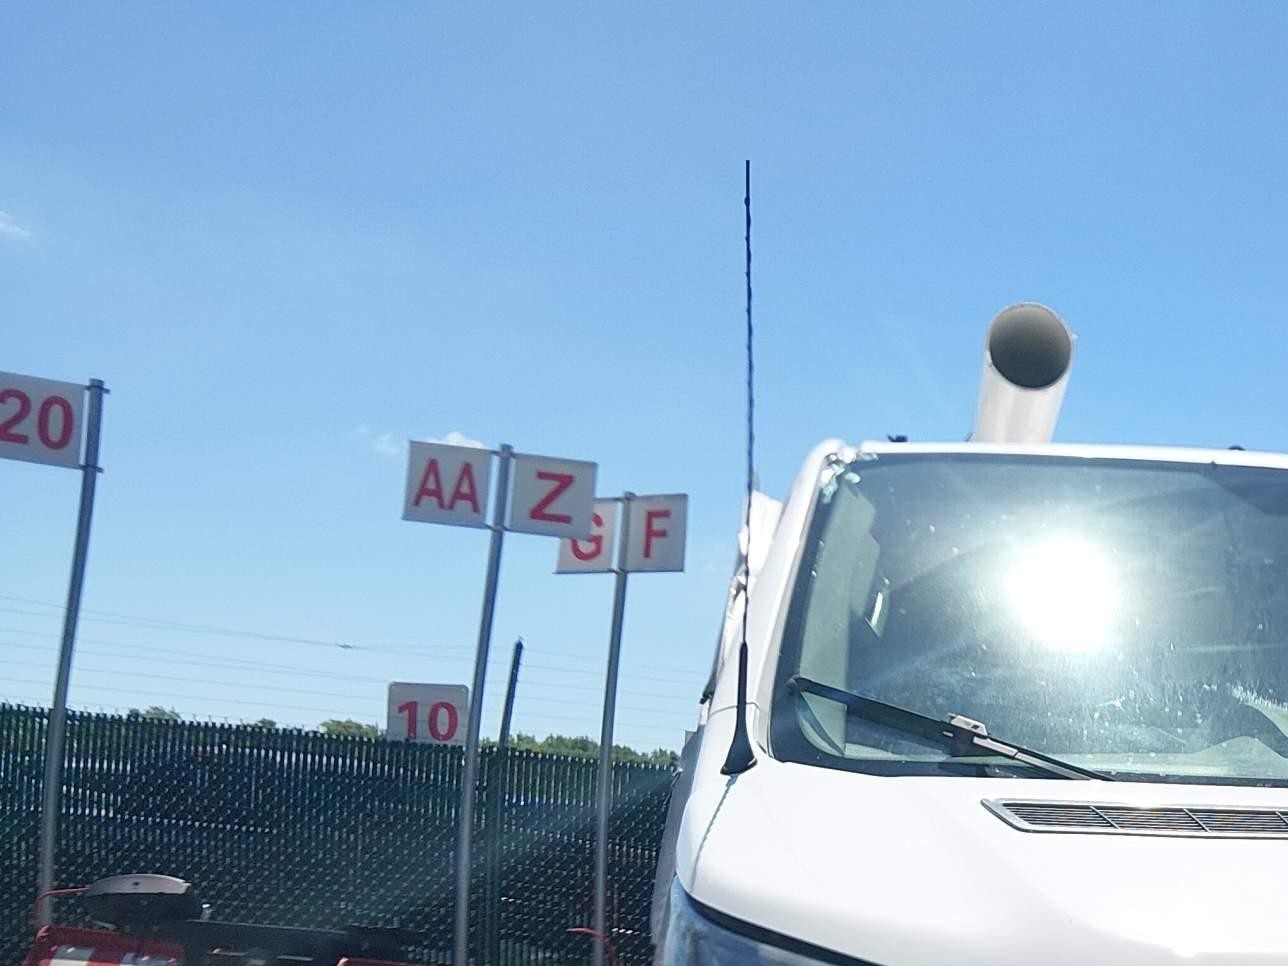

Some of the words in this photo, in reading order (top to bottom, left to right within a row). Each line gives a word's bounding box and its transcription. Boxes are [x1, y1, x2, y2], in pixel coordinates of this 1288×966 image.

[0, 388, 74, 450] 20
[413, 458, 480, 514] AA
[528, 470, 575, 524] Z
[642, 509, 671, 559] F
[397, 701, 458, 742] 10
